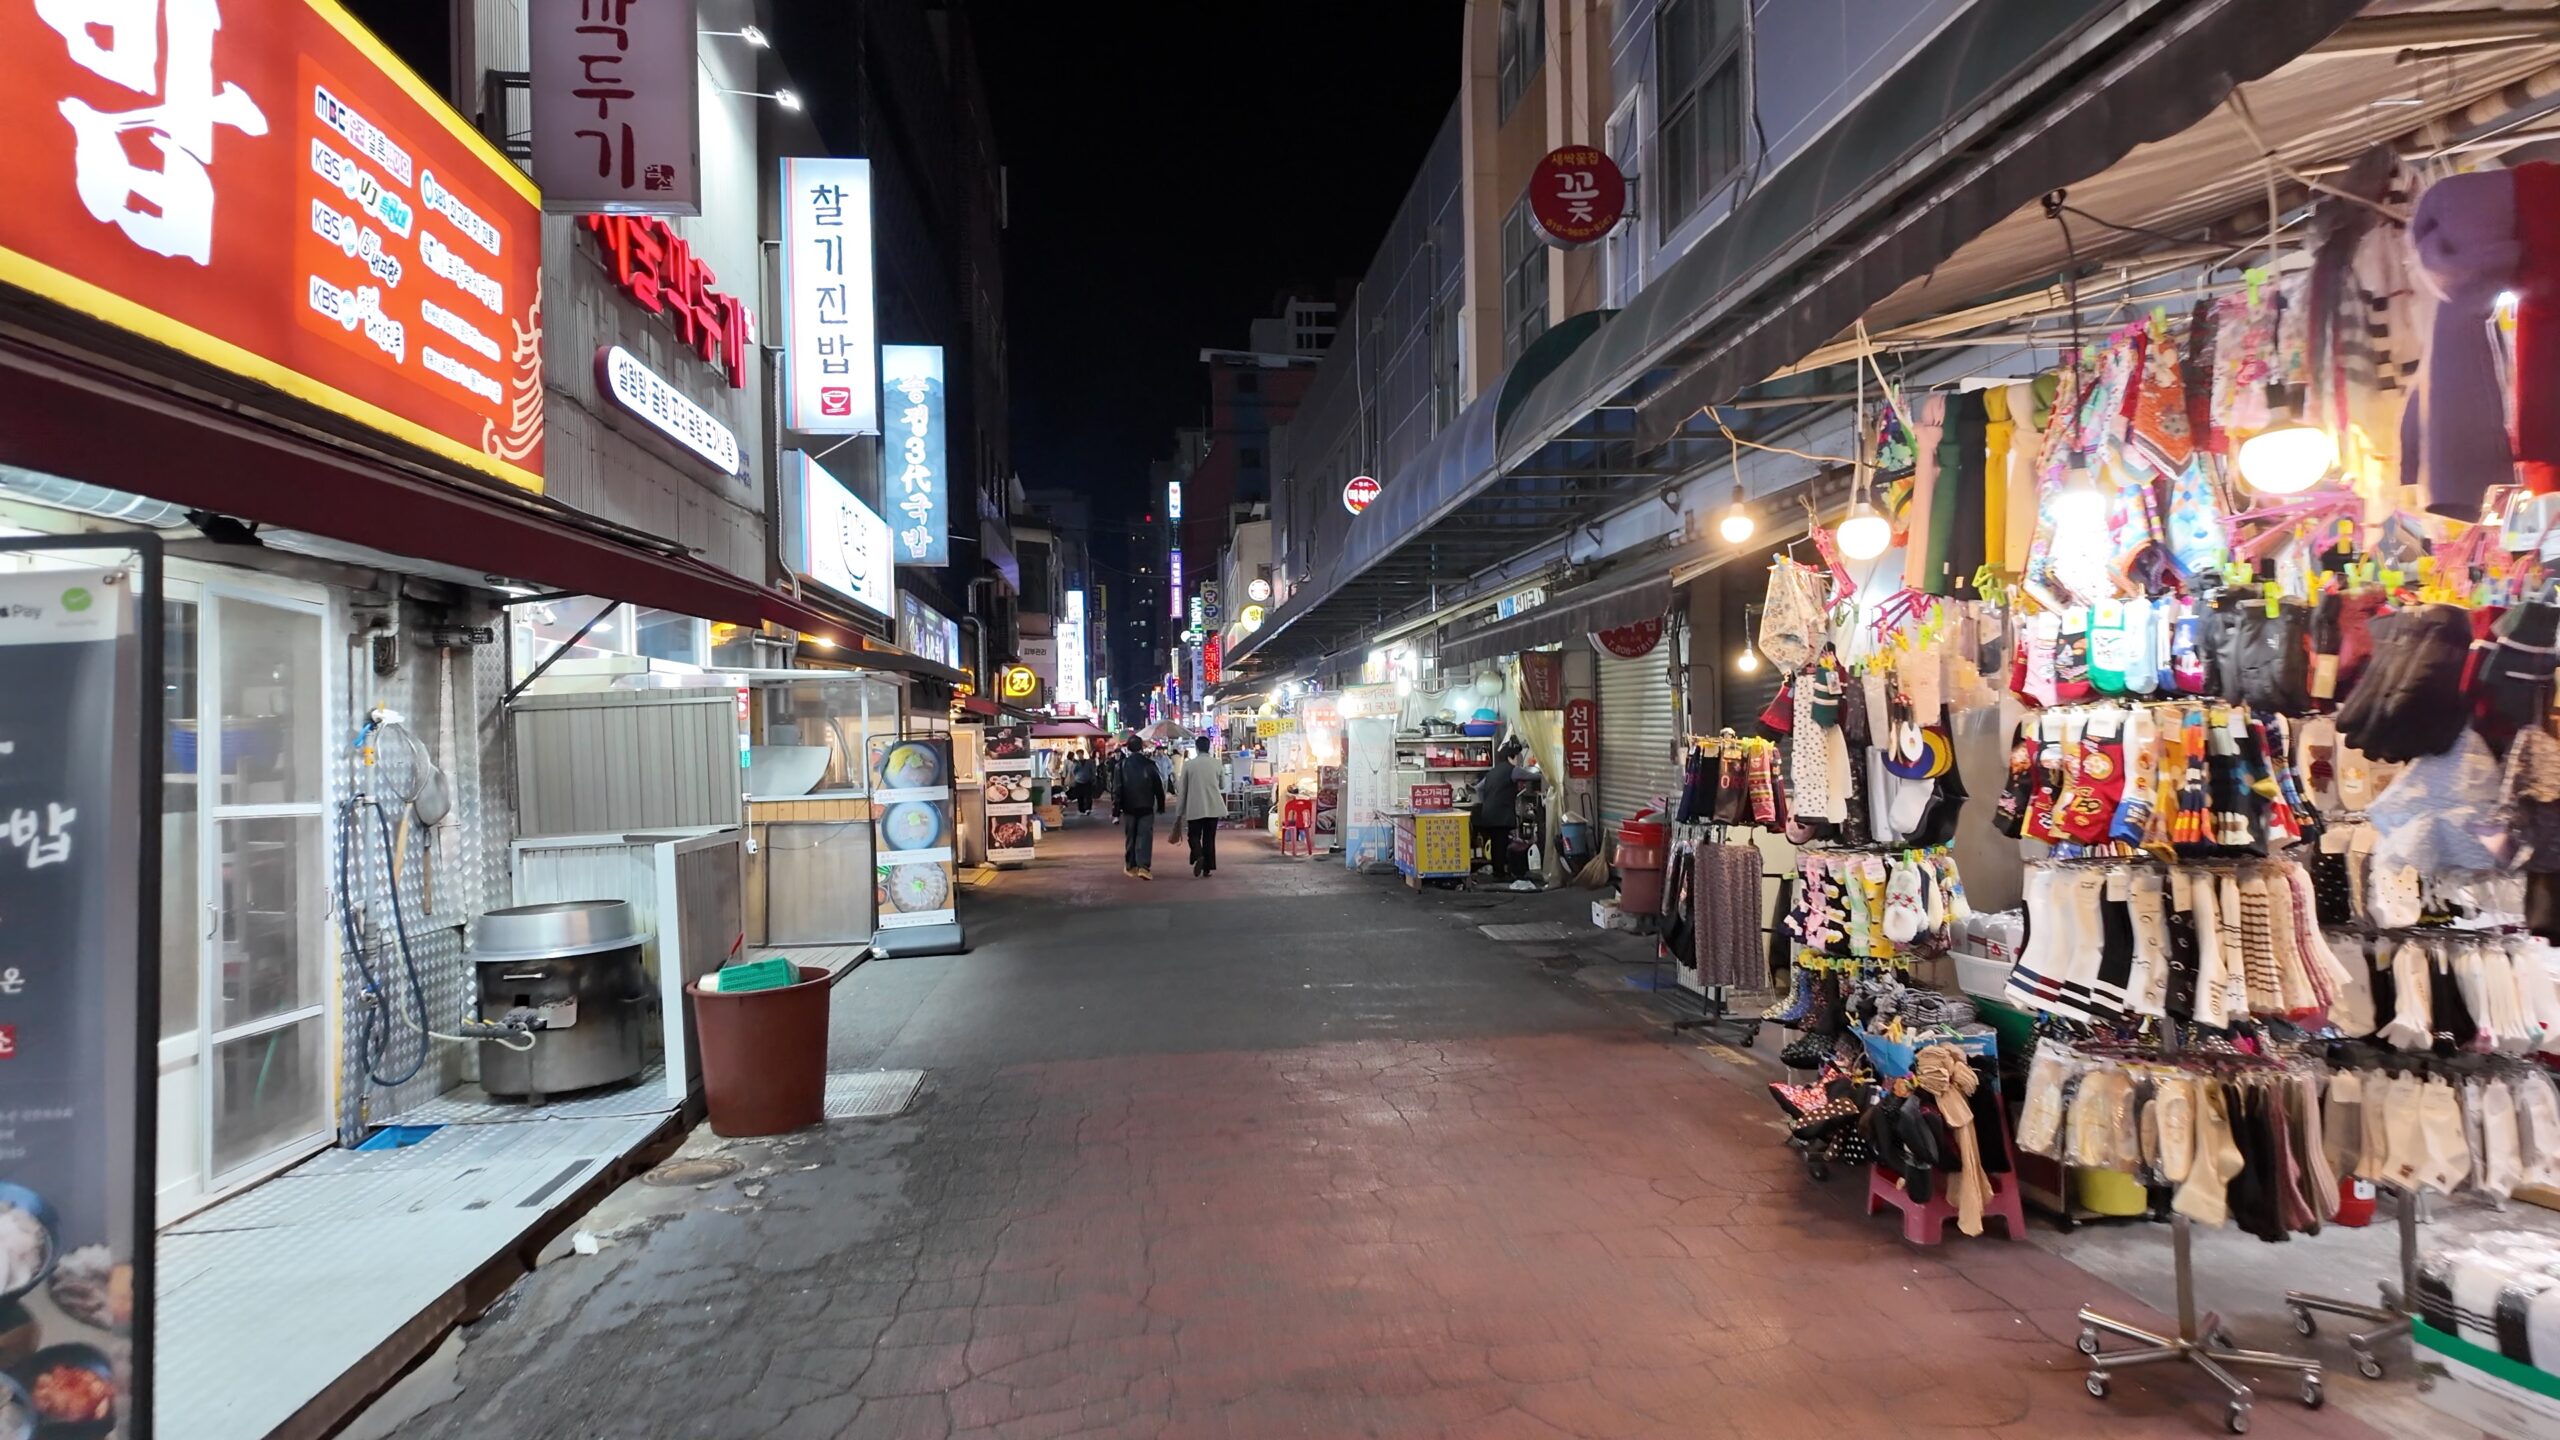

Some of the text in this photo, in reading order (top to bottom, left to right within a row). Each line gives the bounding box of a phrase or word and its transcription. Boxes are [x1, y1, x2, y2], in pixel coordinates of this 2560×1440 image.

[317, 90, 346, 132] MBC
[315, 144, 341, 181] KBS
[1554, 171, 1600, 223] 꽃
[314, 203, 340, 241] KBS
[371, 250, 400, 284] 내고향
[313, 280, 340, 315] KBS
[810, 184, 854, 374] 찰기진밥
[1024, 648, 1047, 656] 피부관리
[1012, 677, 1029, 691] 24
[1569, 706, 1591, 772] 선지국
[1414, 788, 1450, 797] 소고기국밥
